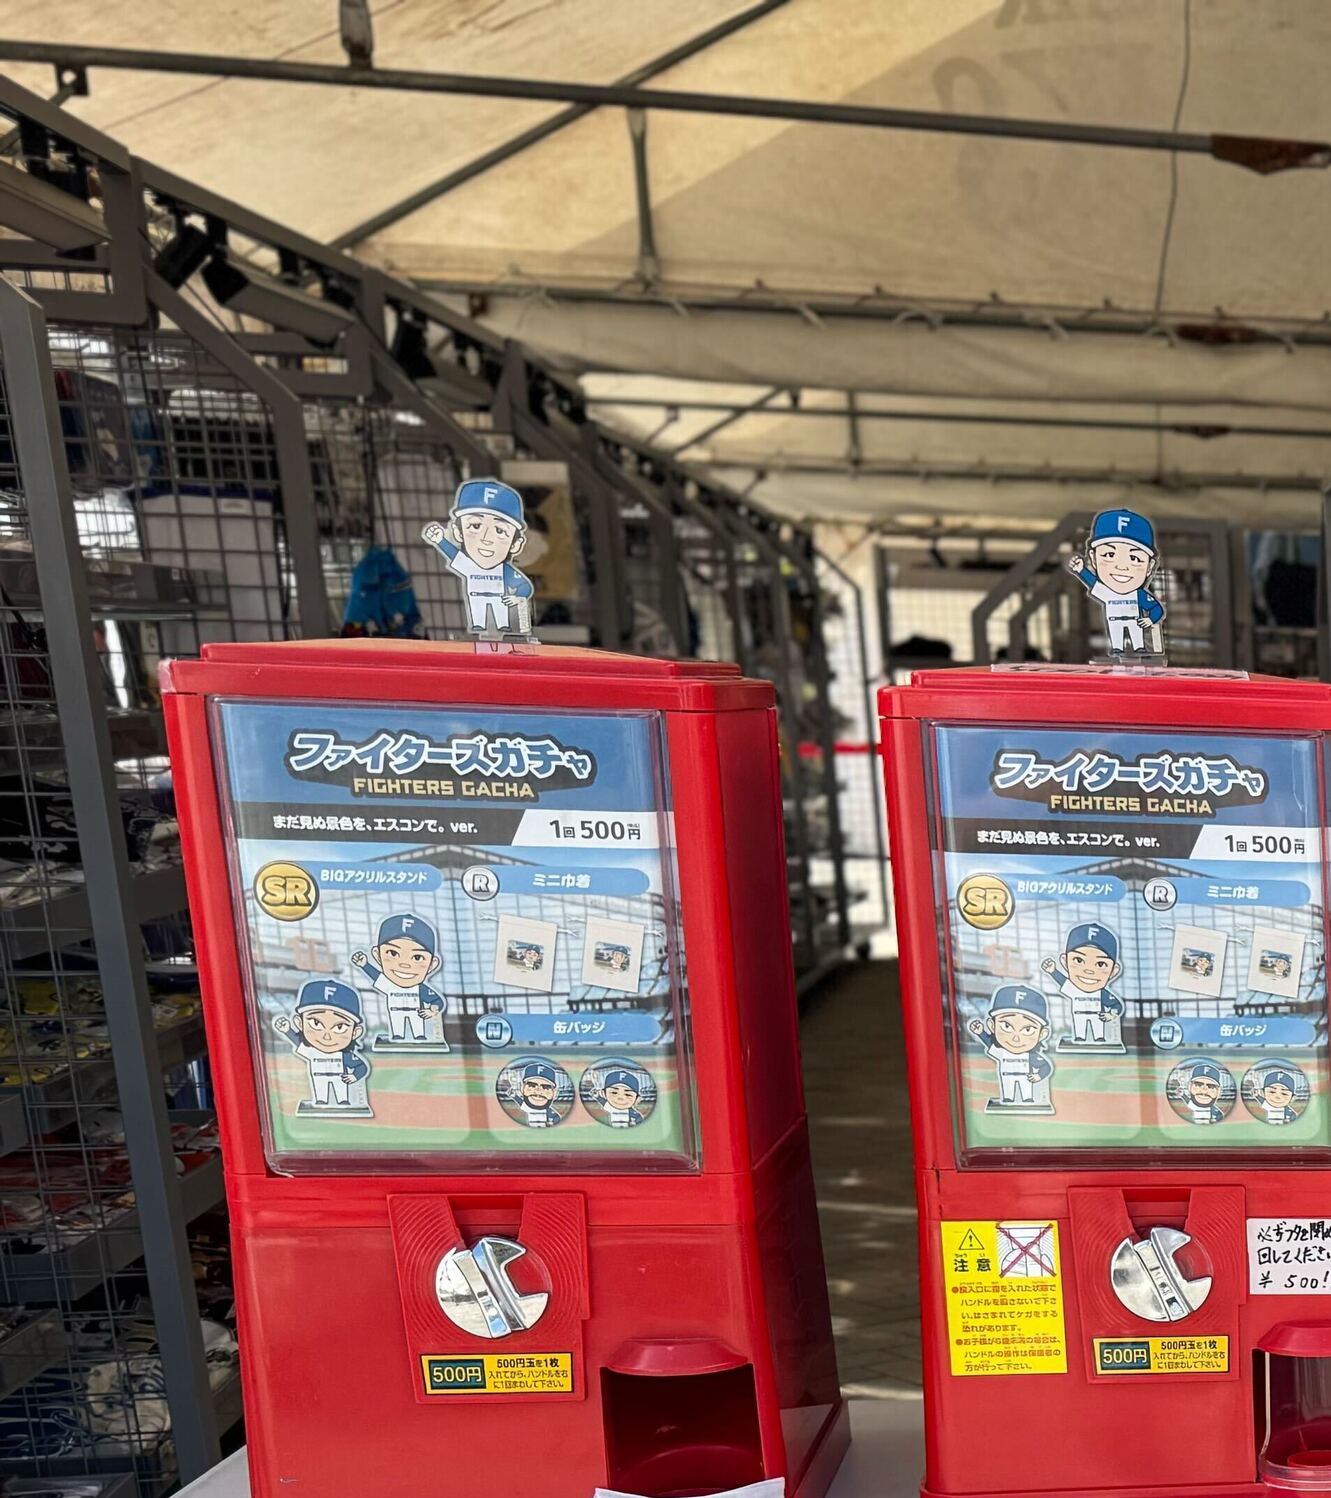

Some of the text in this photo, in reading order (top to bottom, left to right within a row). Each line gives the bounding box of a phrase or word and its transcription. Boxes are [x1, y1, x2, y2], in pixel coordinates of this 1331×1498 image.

[484, 487, 498, 505] F
[1118, 516, 1130, 533] F
[289, 733, 593, 781] ファイターズガチャ
[994, 753, 1265, 797] ファイターズガチャ
[353, 778, 535, 798] FIGHTERS GACHA
[1050, 795, 1212, 814] FIGHTERS GACHA
[273, 815, 478, 834] まだ見ぬ景色を、エスコンで。 ver.
[977, 830, 1160, 848] まだ見ぬ景色を、エスコンで。 ver.
[321, 869, 428, 884] BIGアクリルスタンド
[472, 874, 490, 893] R
[532, 873, 591, 889] ミニ巾着
[262, 875, 313, 908] SR
[1018, 880, 1113, 895] BIGアクリルスタンド
[1153, 887, 1168, 903] R
[1207, 885, 1259, 900] ミニ巾着
[963, 887, 1008, 915] SR
[402, 918, 414, 933] F
[1087, 928, 1098, 941] F
[324, 987, 336, 1001] F
[1014, 992, 1026, 1005] F
[553, 1021, 606, 1034] 缶バッジ
[1219, 1024, 1266, 1037] 缶バッジ
[954, 1258, 991, 1272] 注意
[1161, 1340, 1217, 1350] 500円玉を1枚
[497, 1358, 559, 1368] 500円玉を1枚
[1103, 1348, 1147, 1363] 500円
[433, 1367, 482, 1383] 500円
